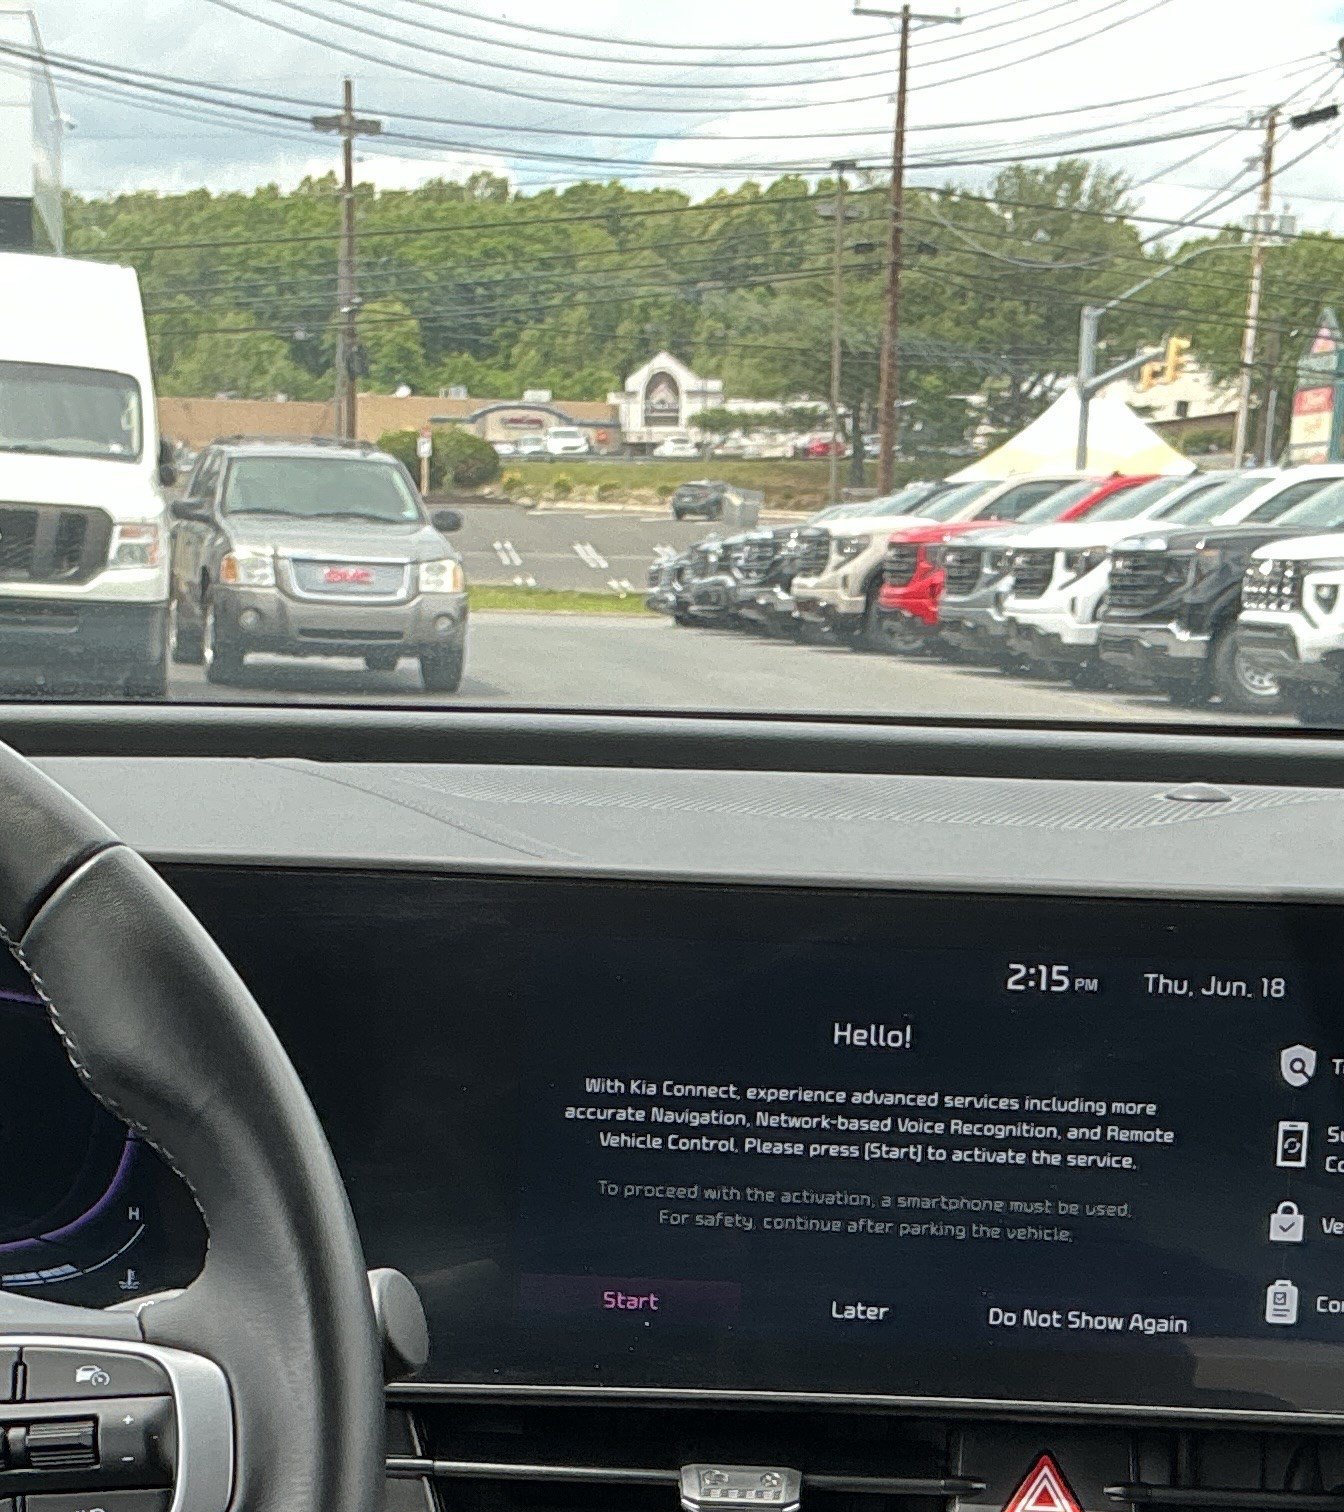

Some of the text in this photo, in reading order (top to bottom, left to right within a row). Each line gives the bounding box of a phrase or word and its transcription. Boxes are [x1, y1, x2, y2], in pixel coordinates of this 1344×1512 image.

[1006, 963, 1099, 992] 2:15 PM
[1200, 975, 1253, 998] Jun.
[1261, 977, 1286, 998] 18
[833, 1022, 912, 1049] Hello!
[585, 1077, 1157, 1117] With Kia Connect, experience advanced services including more
[564, 1106, 1175, 1143] accurate Navigation, Network-based Voice Recognition, and Remote
[599, 1131, 663, 1150] Vehicle
[744, 1137, 805, 1156] Please
[809, 1143, 860, 1158] press
[926, 1145, 947, 1161] to
[951, 1146, 1027, 1165] activate
[1031, 1149, 1062, 1166] the
[1066, 1152, 1137, 1170] service.
[598, 1179, 619, 1196] To
[623, 1184, 699, 1200] proceed
[703, 1186, 741, 1201] with
[745, 1186, 776, 1203] the
[881, 1195, 892, 1208] a
[897, 1194, 1005, 1213] smartphone
[1009, 1199, 1053, 1214] must
[1057, 1200, 1080, 1216] be
[128, 1206, 140, 1221] H
[659, 1209, 691, 1225] For
[762, 1215, 842, 1232] continue
[847, 1217, 895, 1234] after
[899, 1221, 967, 1240] parking
[971, 1222, 1001, 1239] the
[603, 1290, 660, 1311] Start
[831, 1300, 890, 1321] Later
[988, 1307, 1188, 1335] Do Not Show Again
